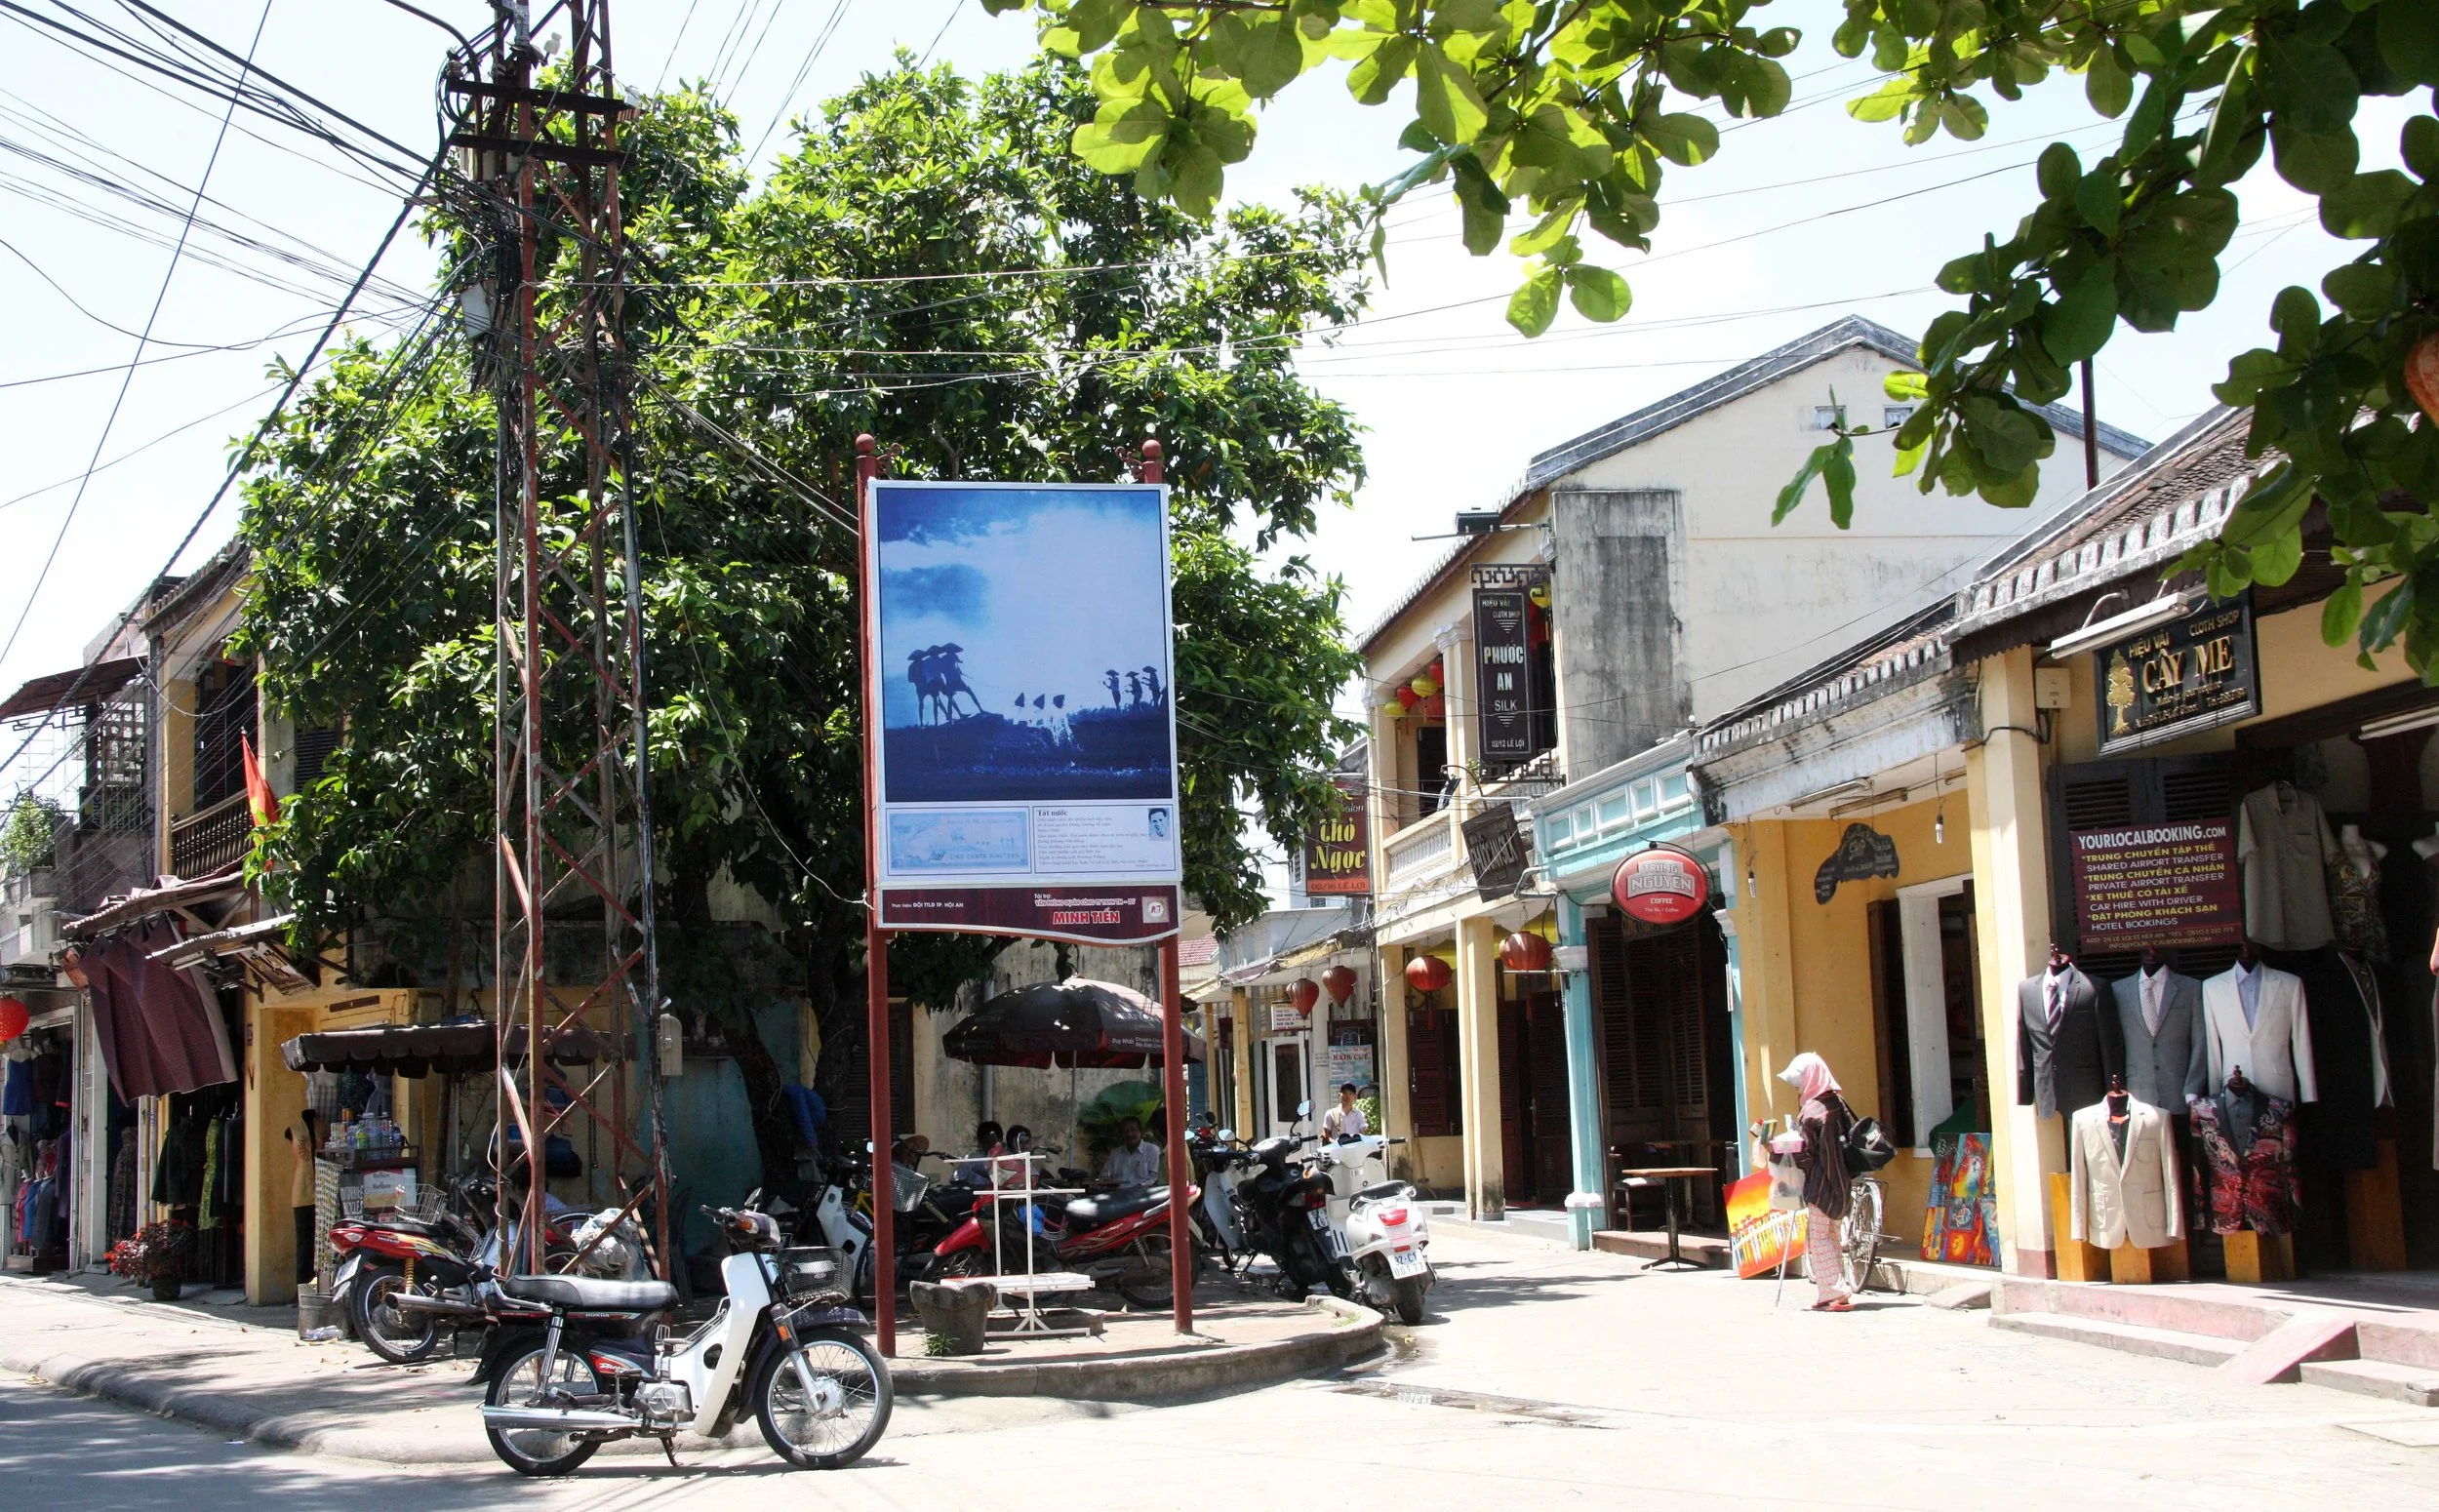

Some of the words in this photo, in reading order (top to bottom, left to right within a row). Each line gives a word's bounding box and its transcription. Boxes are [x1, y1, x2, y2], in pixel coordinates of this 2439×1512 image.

[2189, 619, 2216, 636] CLOTH
[2217, 610, 2240, 627] SHOP
[1483, 640, 1524, 664] PHƯỚC
[2129, 637, 2151, 658] HIỆU
[2154, 629, 2170, 650] VẢI
[2142, 649, 2185, 694] CÂY
[2194, 636, 2235, 678] ME
[1497, 672, 1513, 691] AN
[1495, 700, 1518, 712] SILK
[2078, 825, 2226, 850] YOURLOCALBOOKING.COM
[2174, 845, 2191, 855] TẬP
[1310, 846, 1366, 874] Ngọc
[1644, 863, 1678, 873] TRUNG
[2086, 862, 2128, 872] SHARED
[2131, 858, 2170, 868] AIRPORT
[2173, 853, 2224, 864] TRANSFER
[2175, 864, 2190, 874] CÁ
[2192, 862, 2225, 872] NHÂN
[2088, 881, 2128, 892] PRIVATE
[2131, 878, 2170, 888] AIRPORT
[2174, 872, 2224, 884] TRANSFER
[2105, 889, 2134, 899] THUÊ
[2137, 888, 2152, 897] CÓ
[2090, 902, 2109, 911] CAR
[2113, 899, 2137, 909] HIRE
[2139, 897, 2164, 907] WITH
[2166, 895, 2203, 905] DRIVER
[2115, 908, 2152, 919] PHÒNG
[2155, 903, 2192, 916] KHÁCH
[2195, 903, 2218, 914] SẠN
[1053, 911, 1091, 925] MINH
[1091, 907, 1120, 924] TIẾN
[2092, 920, 2123, 931] HOTEL
[2125, 917, 2179, 929] BOOKINGS
